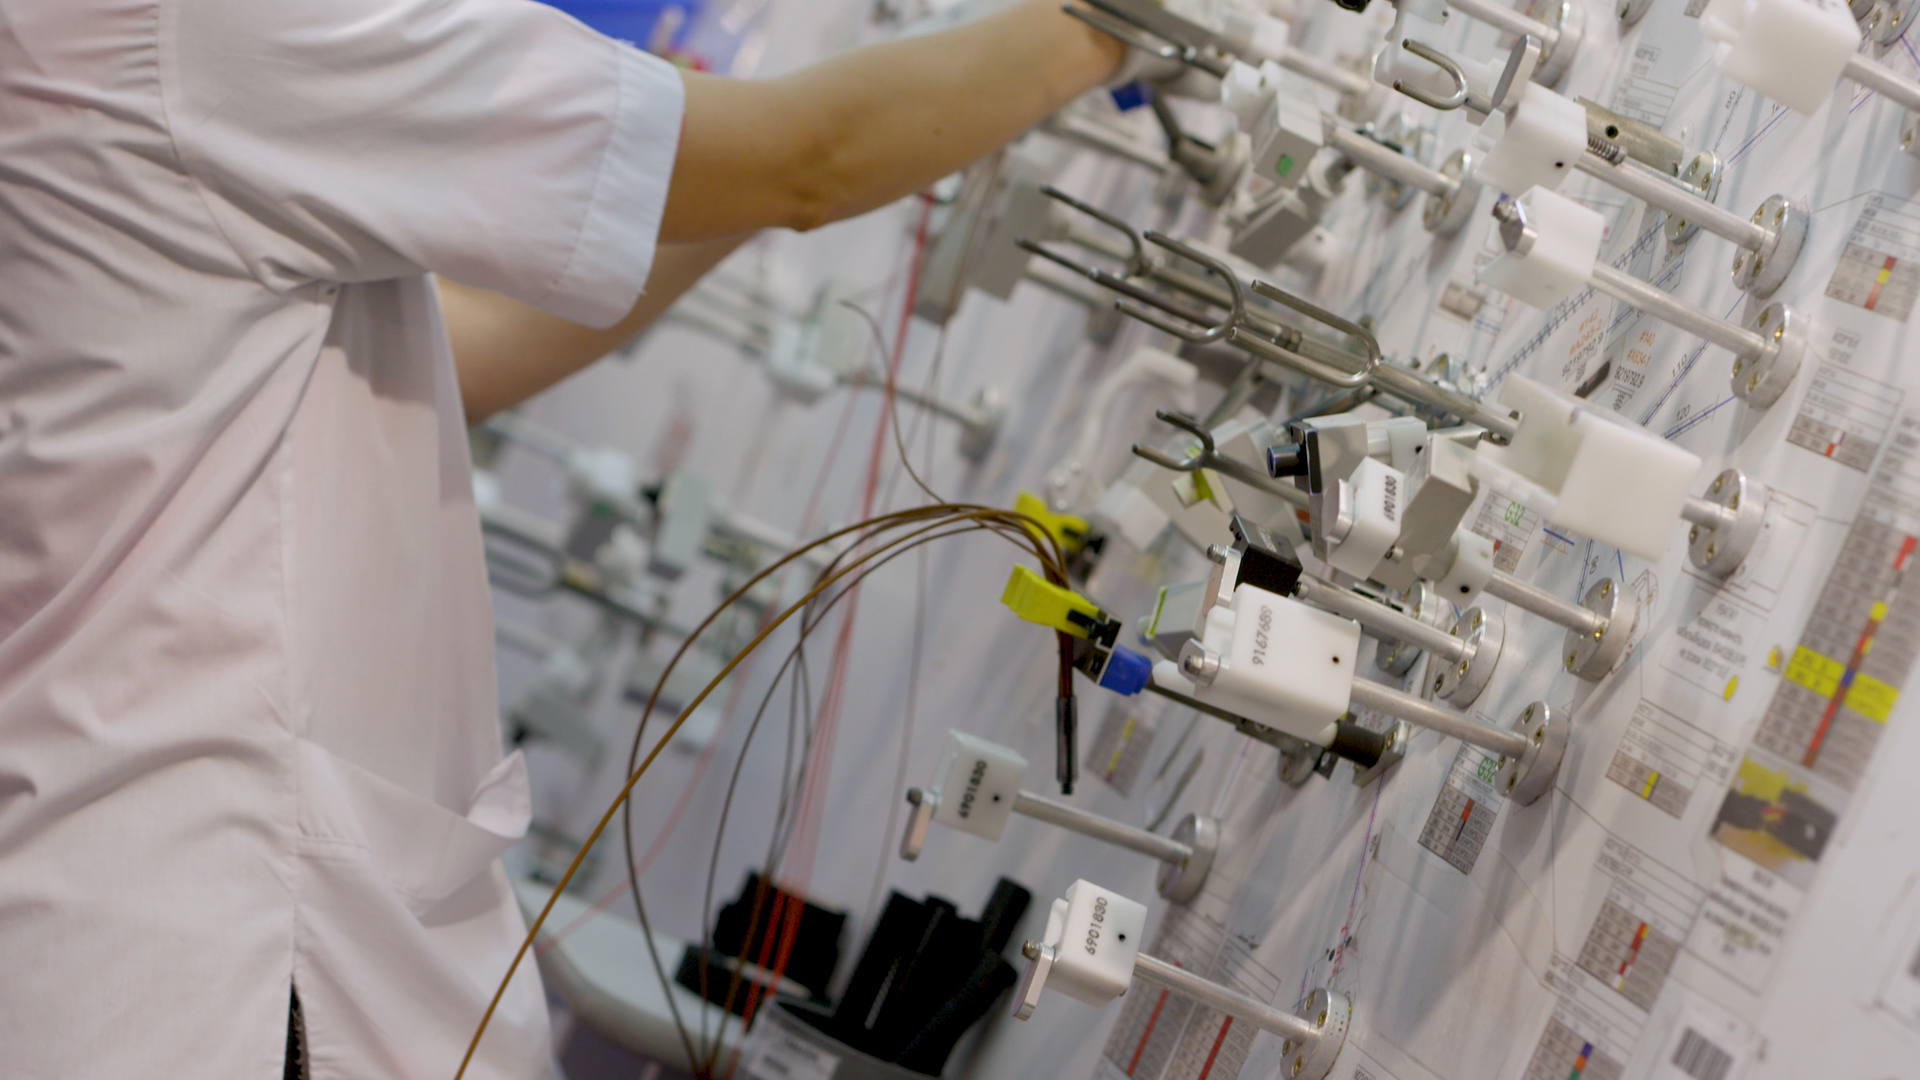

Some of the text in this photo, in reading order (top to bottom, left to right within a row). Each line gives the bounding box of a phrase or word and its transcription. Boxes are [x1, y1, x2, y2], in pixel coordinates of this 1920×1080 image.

[1676, 404, 1691, 422] 120
[1504, 500, 1526, 528] G32
[1252, 604, 1273, 667] 9167689
[957, 759, 988, 820] 6901830
[1084, 895, 1109, 956] 6901830
